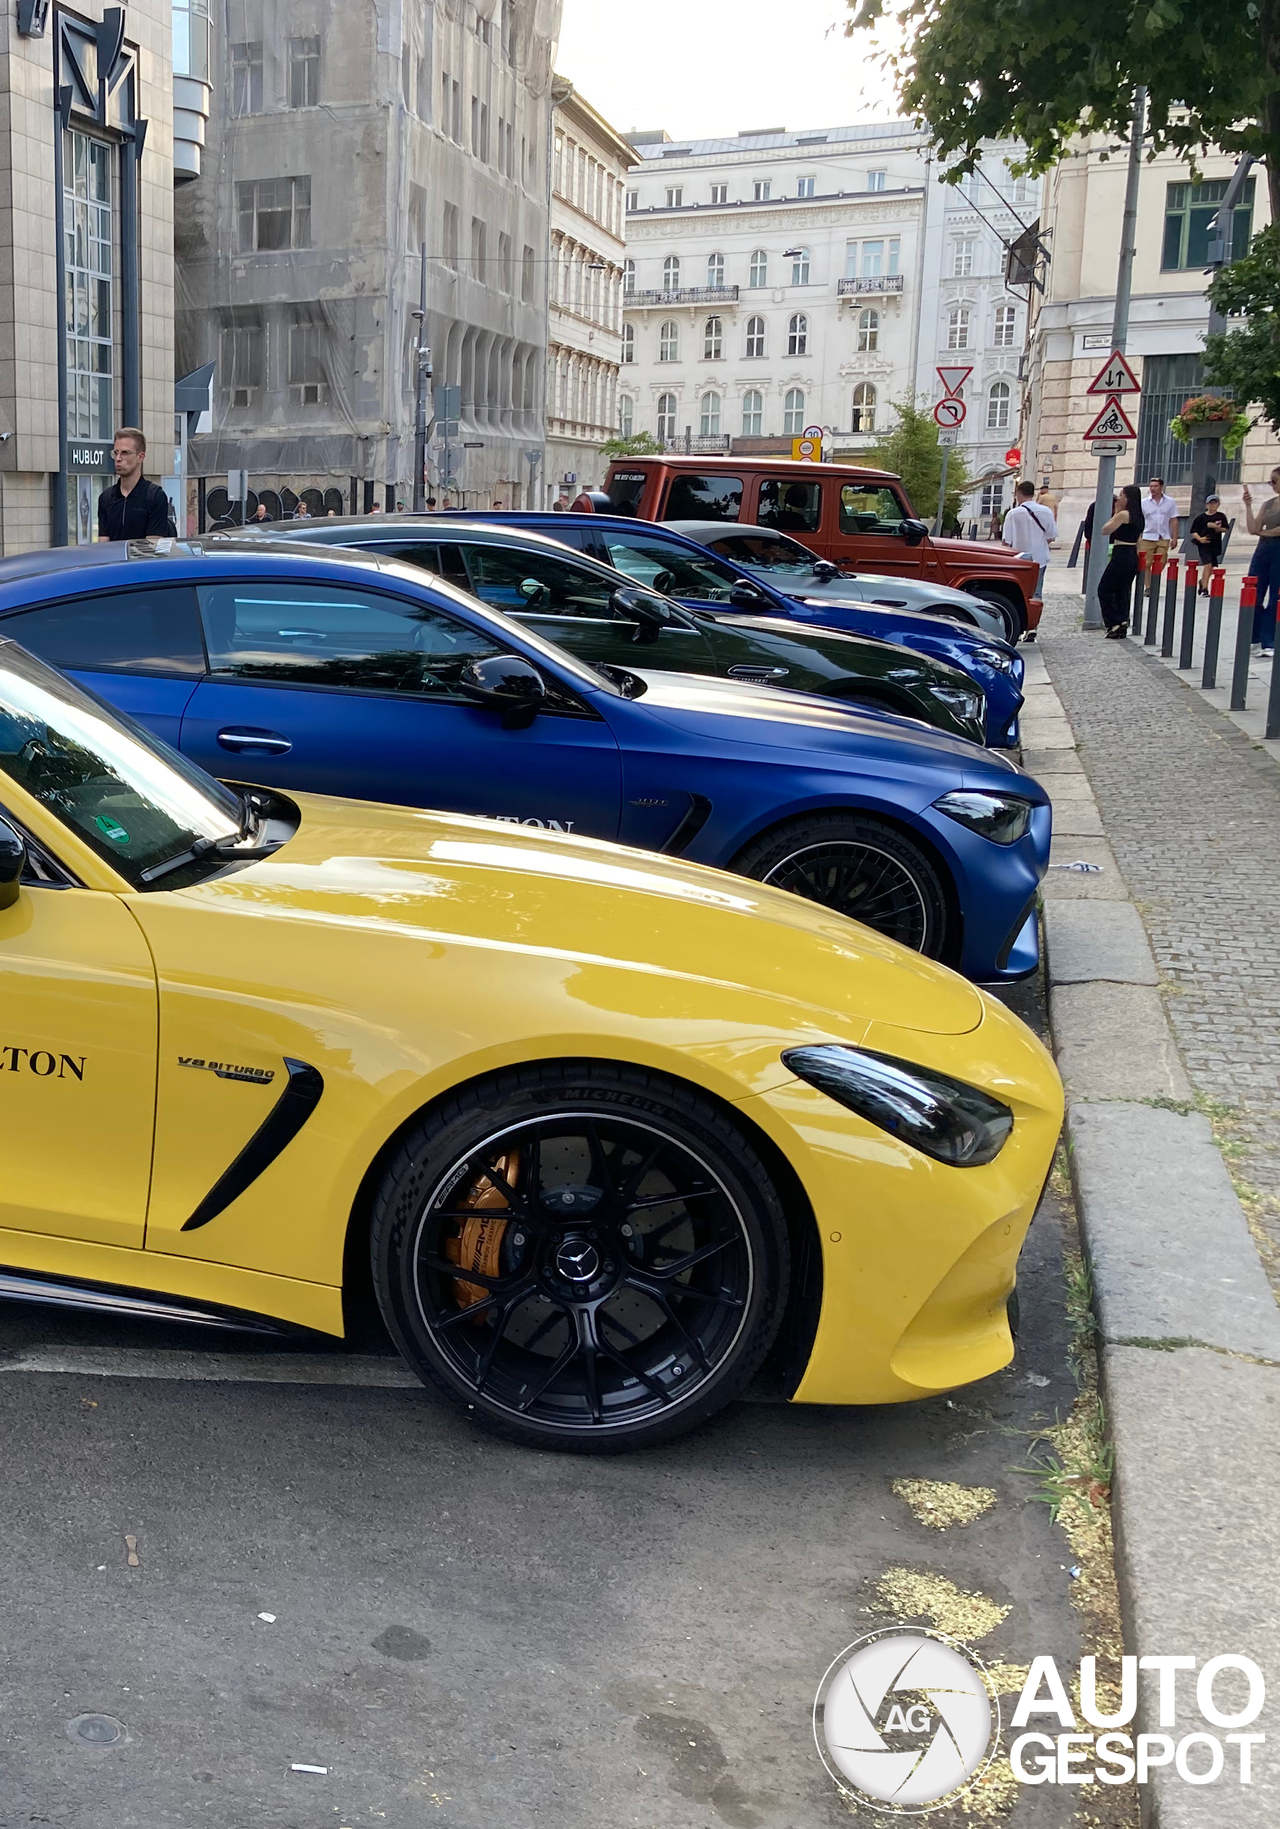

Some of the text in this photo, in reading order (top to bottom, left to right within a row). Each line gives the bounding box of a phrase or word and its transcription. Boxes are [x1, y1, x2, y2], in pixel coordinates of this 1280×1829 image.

[72, 449, 104, 465] HUBLOT
[178, 1056, 275, 1078] V8 BITURBO
[564, 1088, 669, 1116] MICHELIN
